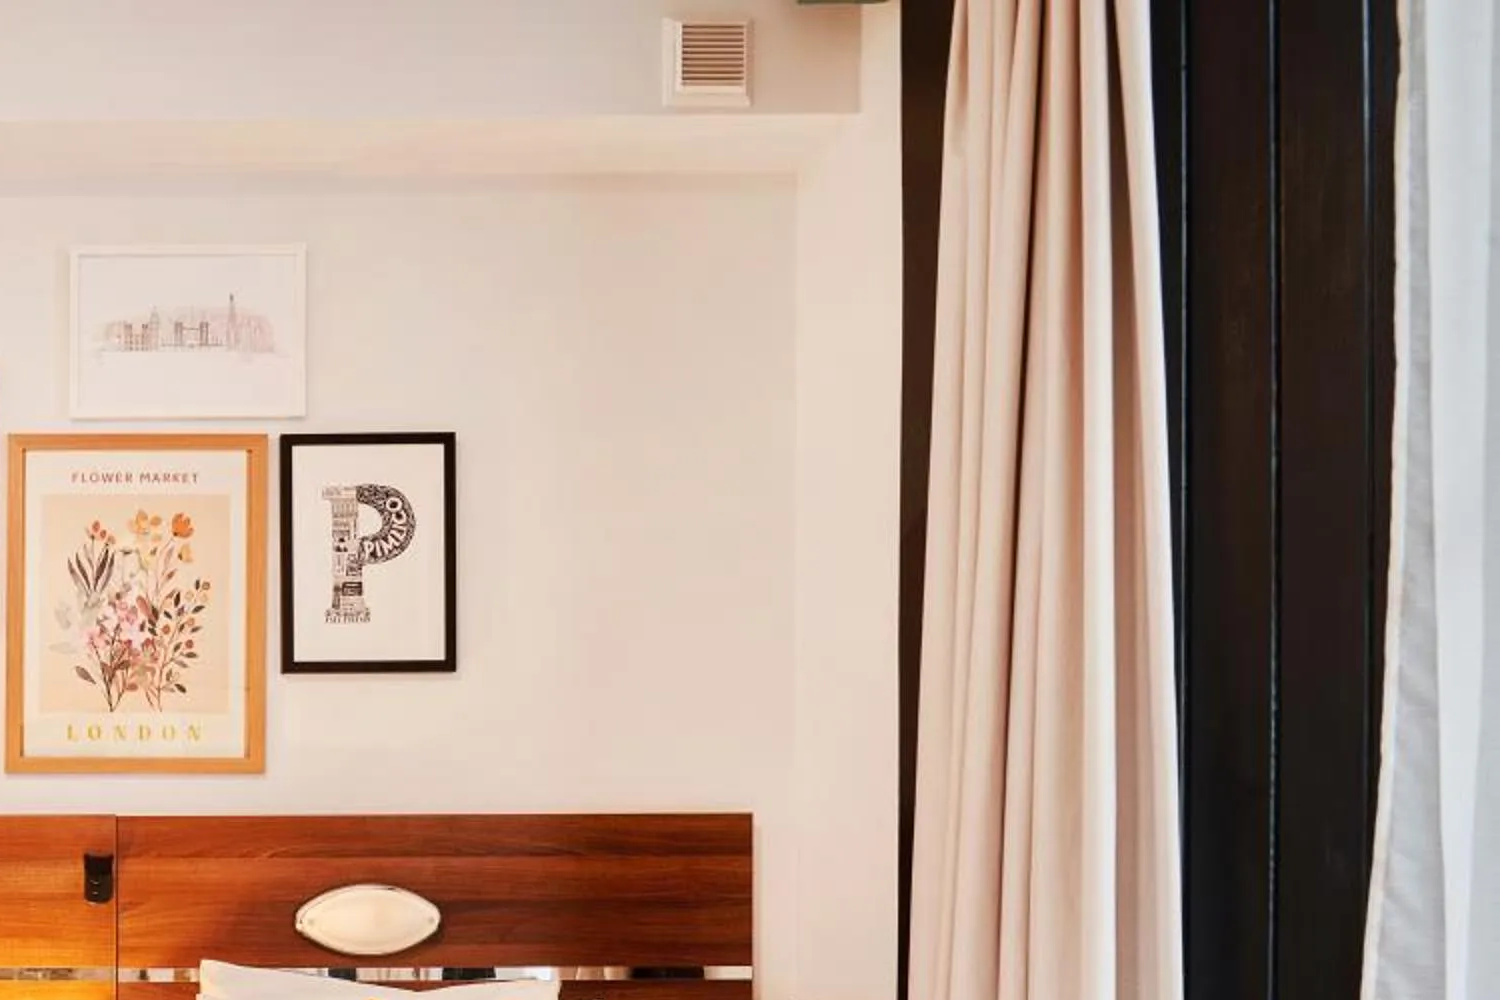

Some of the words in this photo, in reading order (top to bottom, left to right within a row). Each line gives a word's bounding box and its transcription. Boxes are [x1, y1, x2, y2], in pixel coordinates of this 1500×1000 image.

[71, 472, 133, 484] FLOWER
[139, 472, 198, 484] MARKET
[66, 723, 202, 742] LONDON
